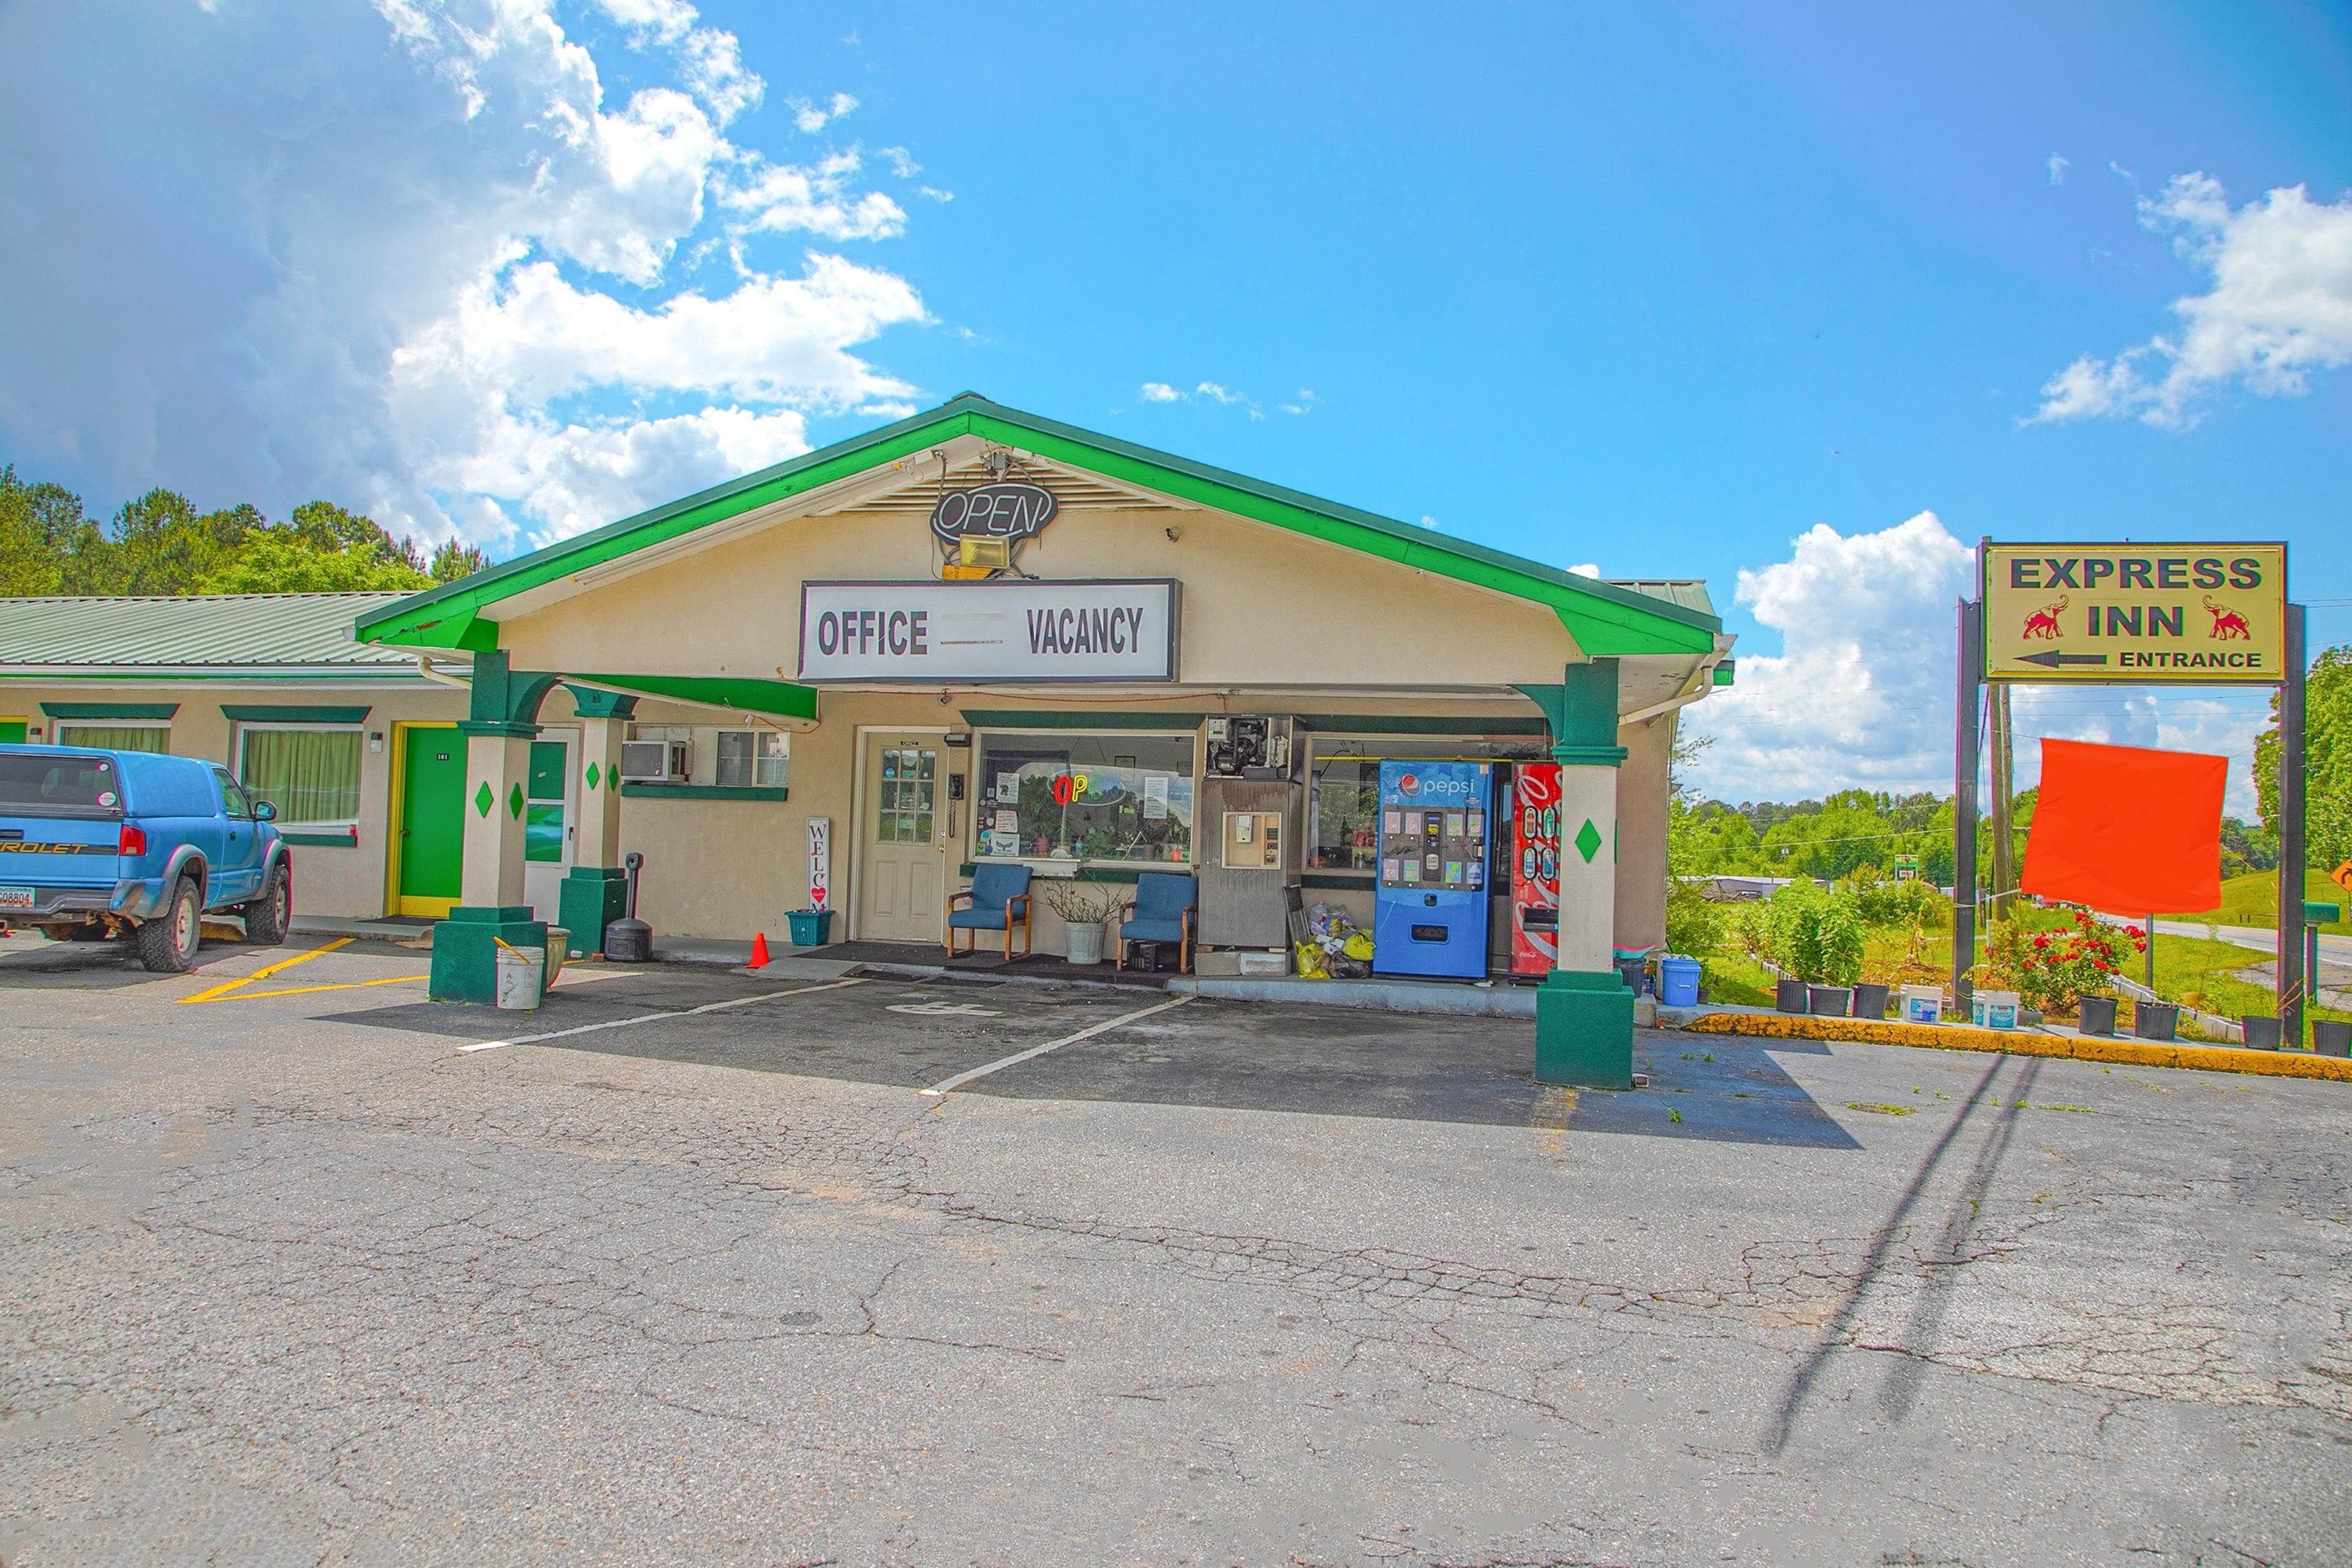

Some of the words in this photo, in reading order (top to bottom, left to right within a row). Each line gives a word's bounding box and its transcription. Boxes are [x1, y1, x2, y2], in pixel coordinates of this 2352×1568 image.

[939, 493, 1043, 532] OPEN
[2011, 559, 2262, 589] EXPRESS
[818, 611, 928, 656] OFFICE
[1027, 608, 1144, 655] VACANCY
[2088, 606, 2183, 636] INN
[2119, 652, 2261, 667] ENTRANCE
[1424, 779, 1474, 796] pepsi
[0, 842, 88, 854] ROLET
